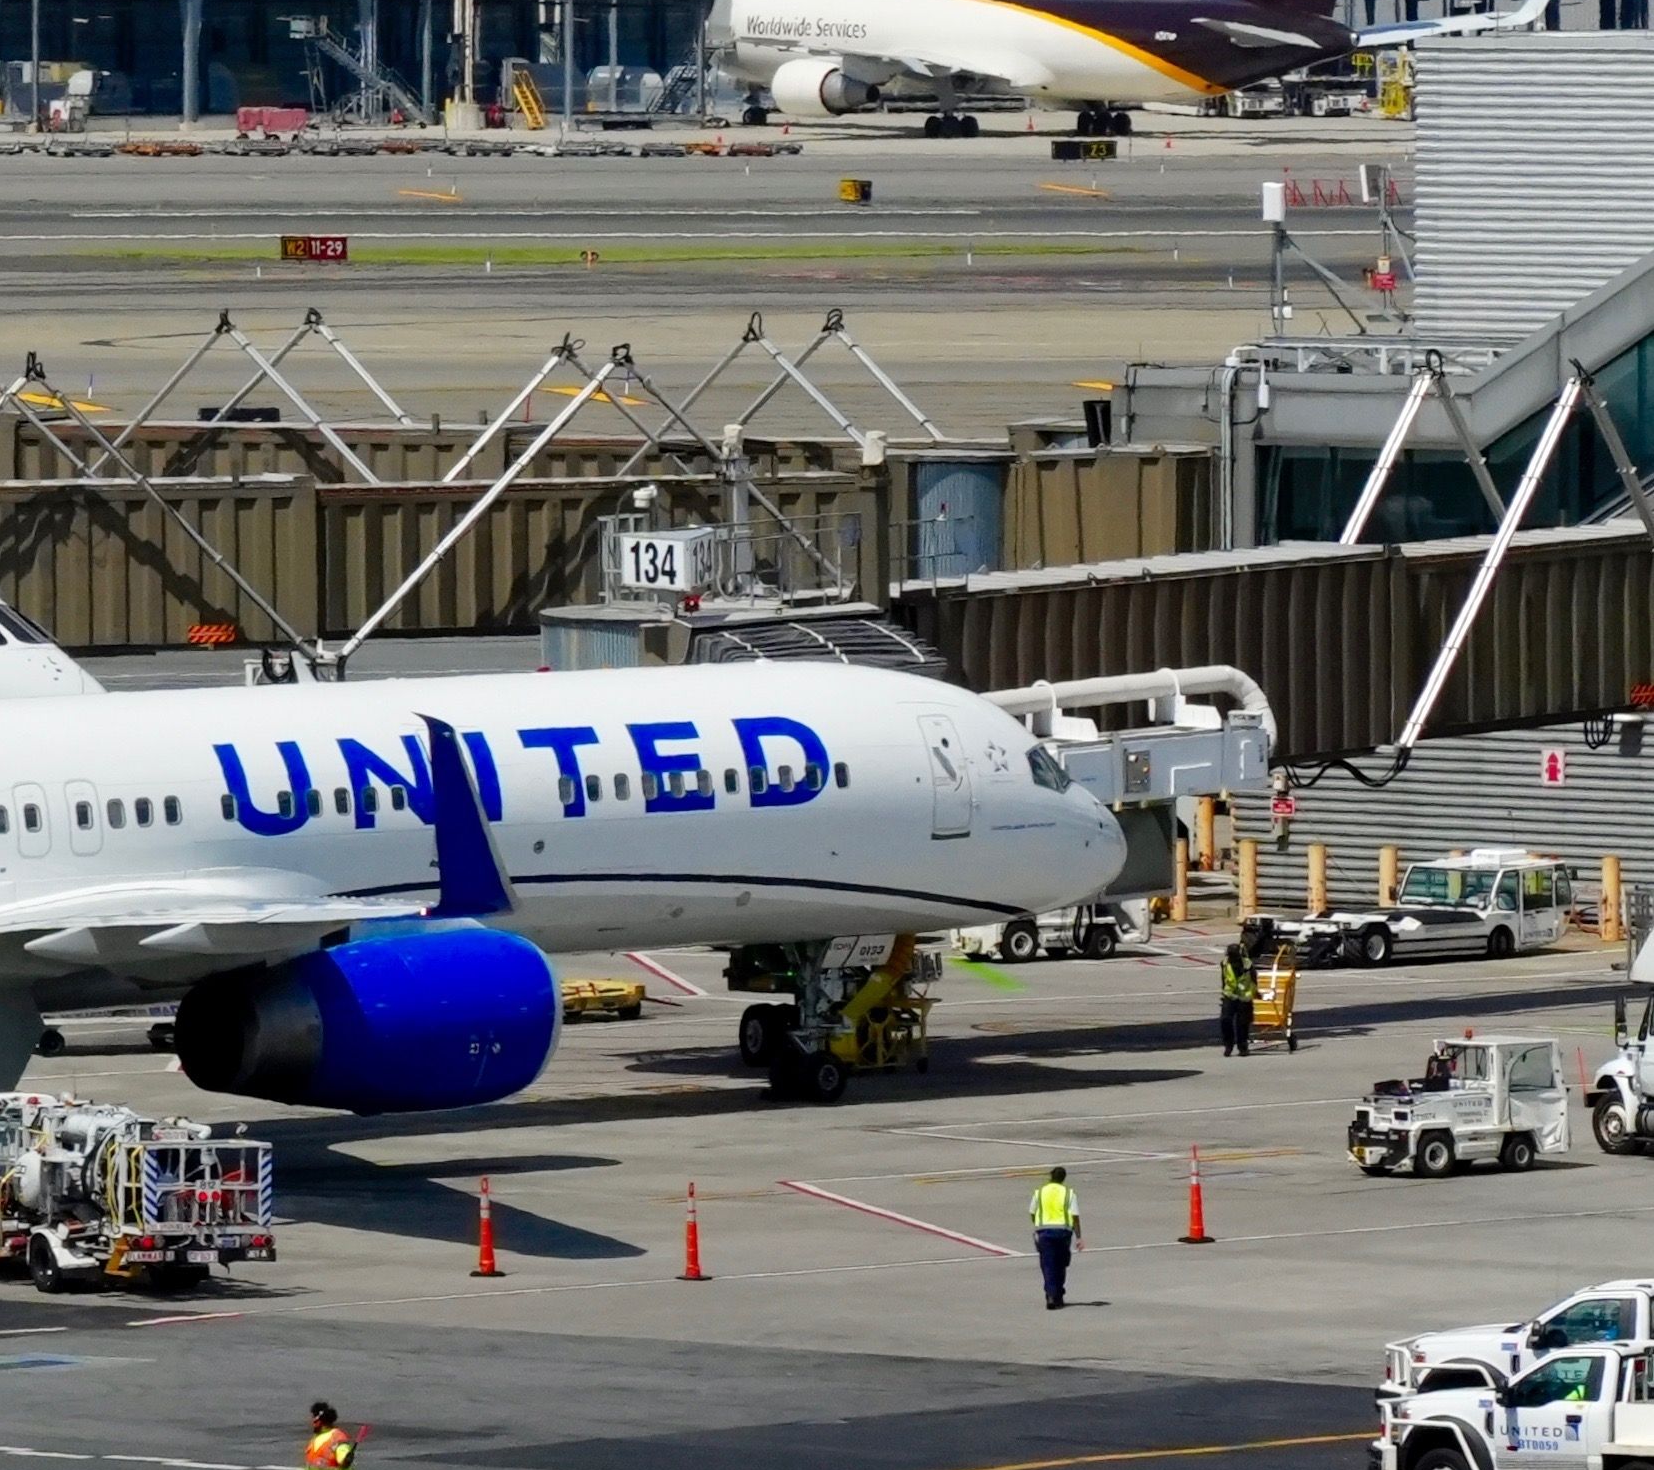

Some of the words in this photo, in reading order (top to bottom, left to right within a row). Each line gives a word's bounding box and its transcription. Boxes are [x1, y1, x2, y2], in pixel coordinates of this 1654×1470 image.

[744, 17, 812, 38] Worldwide
[817, 18, 867, 38] Services
[1090, 145, 1106, 157] Z3
[310, 241, 343, 256] 11-29
[629, 541, 677, 586] 134
[690, 539, 712, 581] 134
[213, 715, 829, 836] UNITED
[859, 945, 885, 957] 0133
[1500, 1426, 1562, 1438] UNITED
